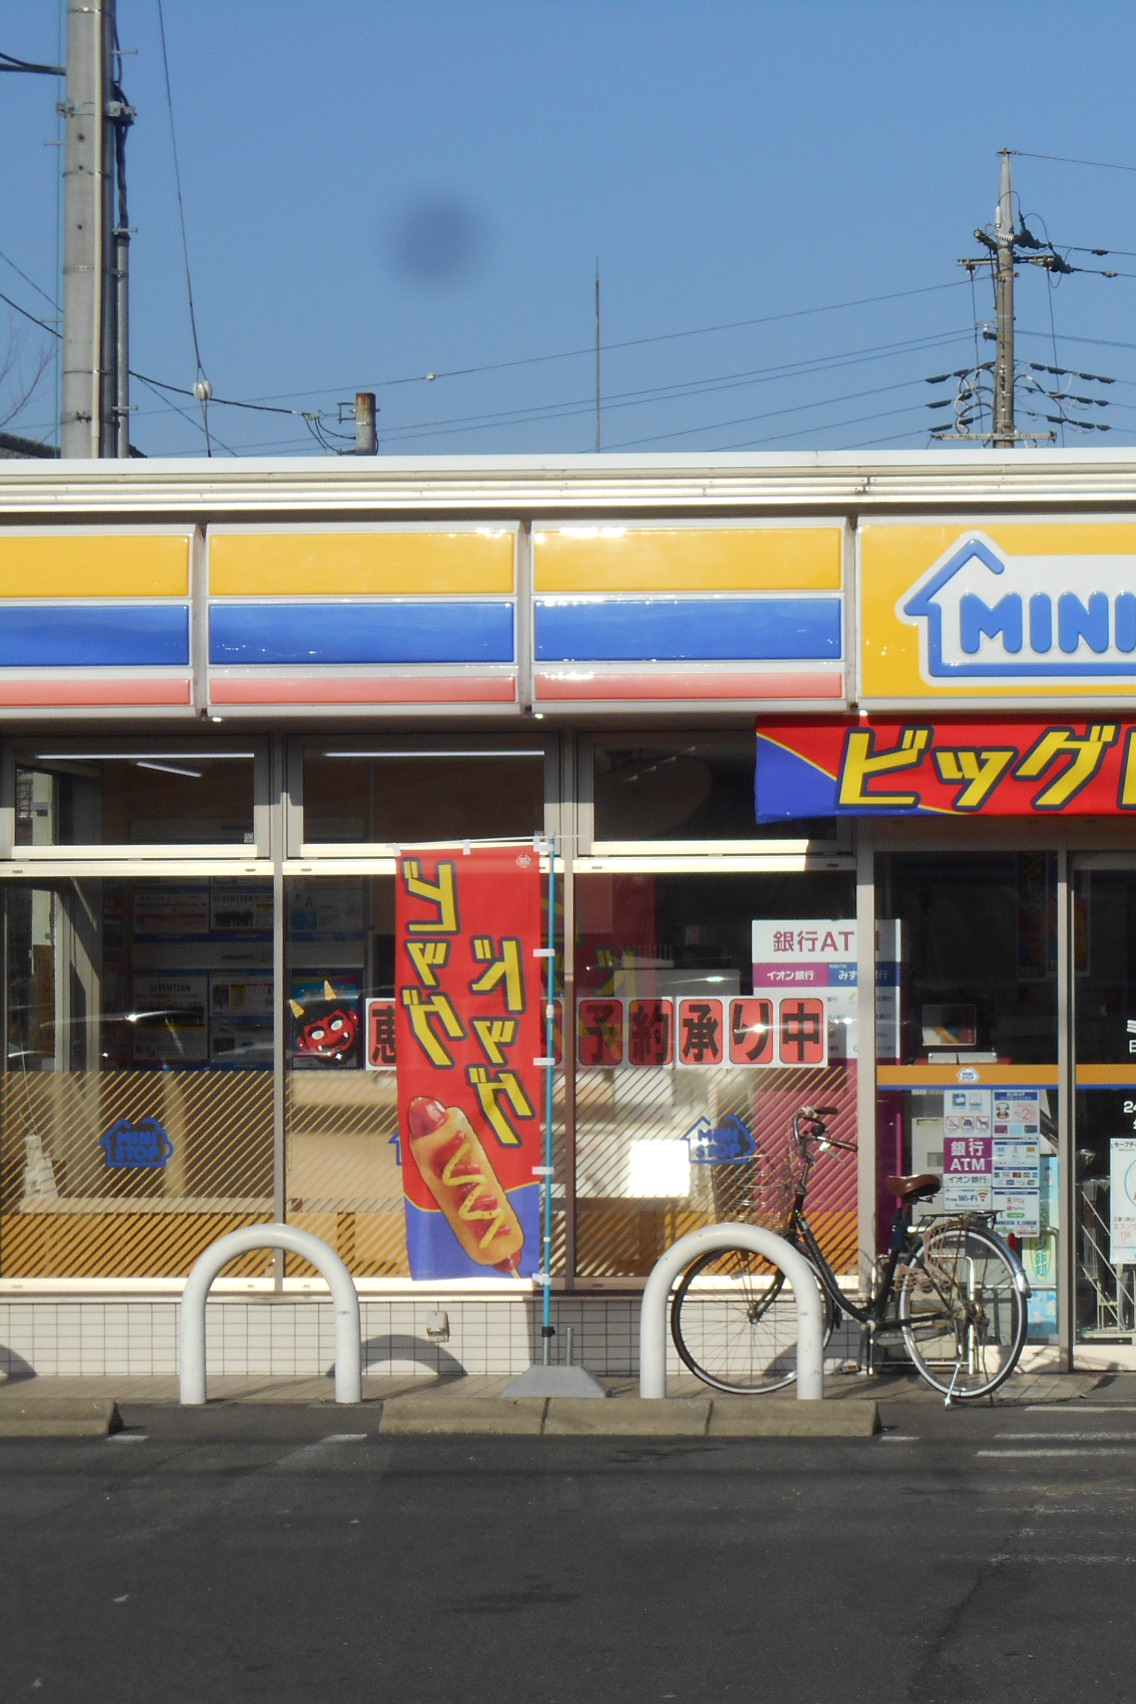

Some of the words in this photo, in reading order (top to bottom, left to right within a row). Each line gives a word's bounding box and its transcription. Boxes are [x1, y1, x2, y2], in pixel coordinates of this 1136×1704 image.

[773, 931, 880, 952] 銀行AT
[766, 970, 815, 982] イオン銀行
[580, 1001, 821, 1064] 予約承り中
[116, 1131, 158, 1146] MINI
[697, 1128, 740, 1143] MINI
[115, 1146, 160, 1161] STOP
[695, 1143, 741, 1158] STOP
[950, 1140, 985, 1157] 銀行
[949, 1158, 986, 1171] ATM
[948, 1175, 987, 1184] イオン銀行
